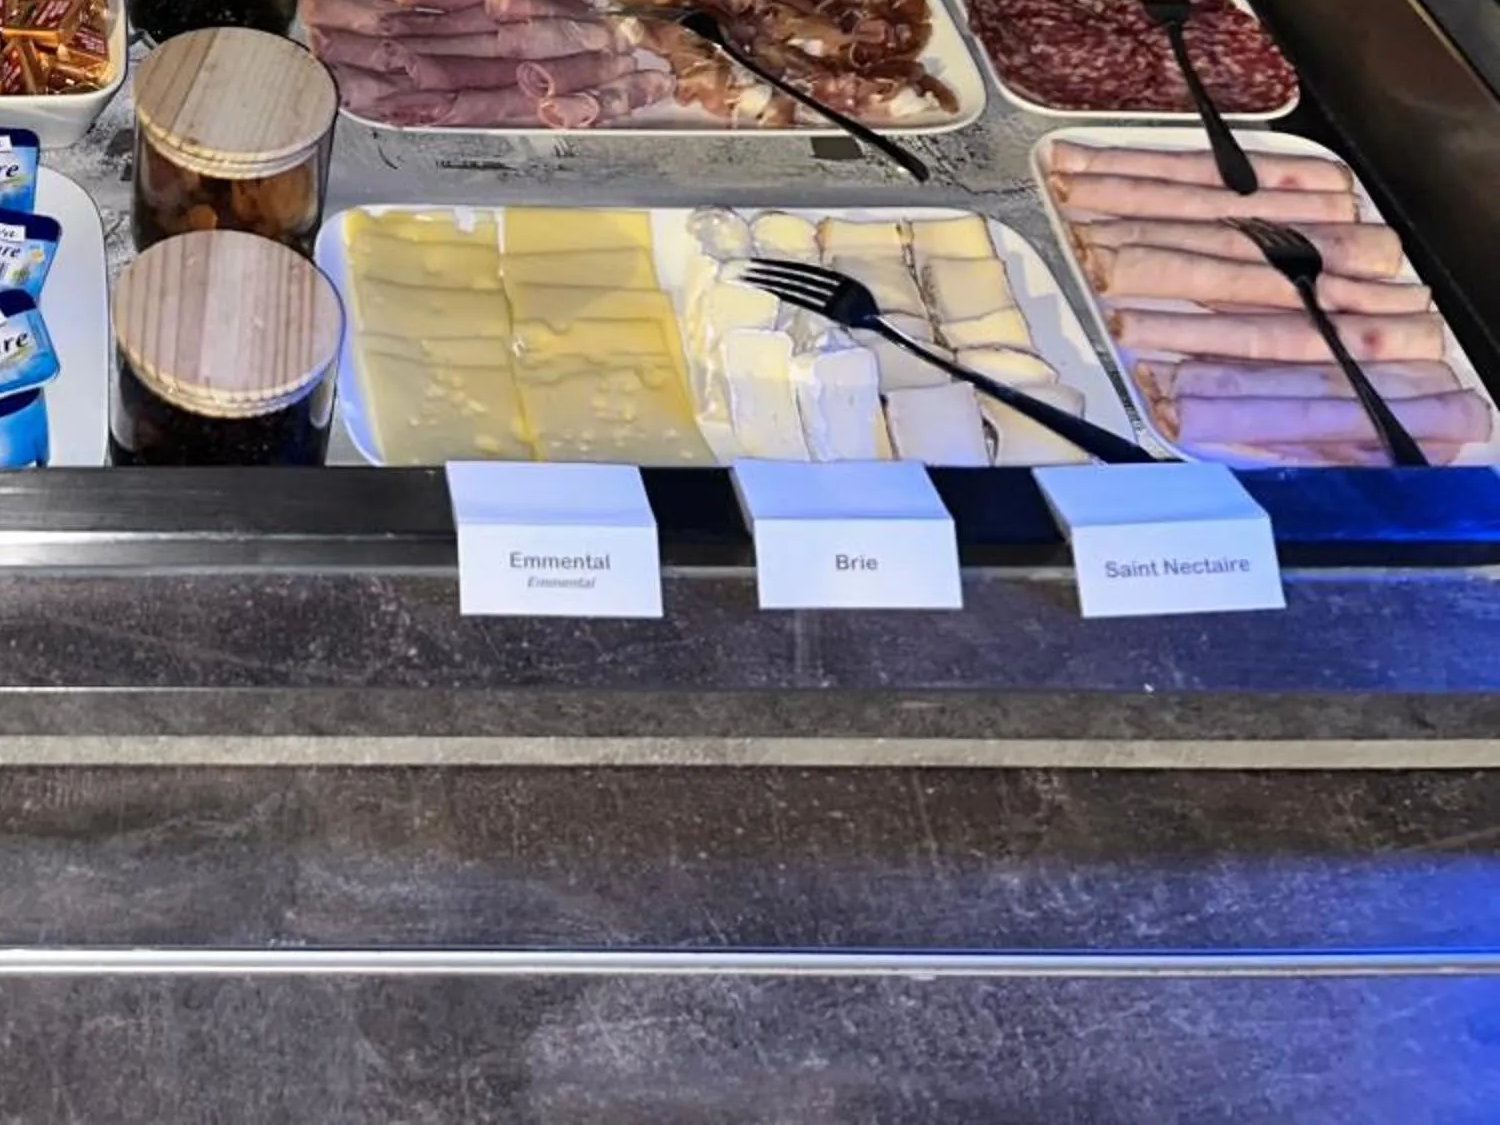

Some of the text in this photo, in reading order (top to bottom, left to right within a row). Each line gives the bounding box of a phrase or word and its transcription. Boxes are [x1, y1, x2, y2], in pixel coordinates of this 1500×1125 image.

[509, 551, 611, 571] Emmental
[835, 554, 879, 571] Brie
[1105, 556, 1251, 578] Saint Nectaire
[527, 575, 597, 589] Emmental
